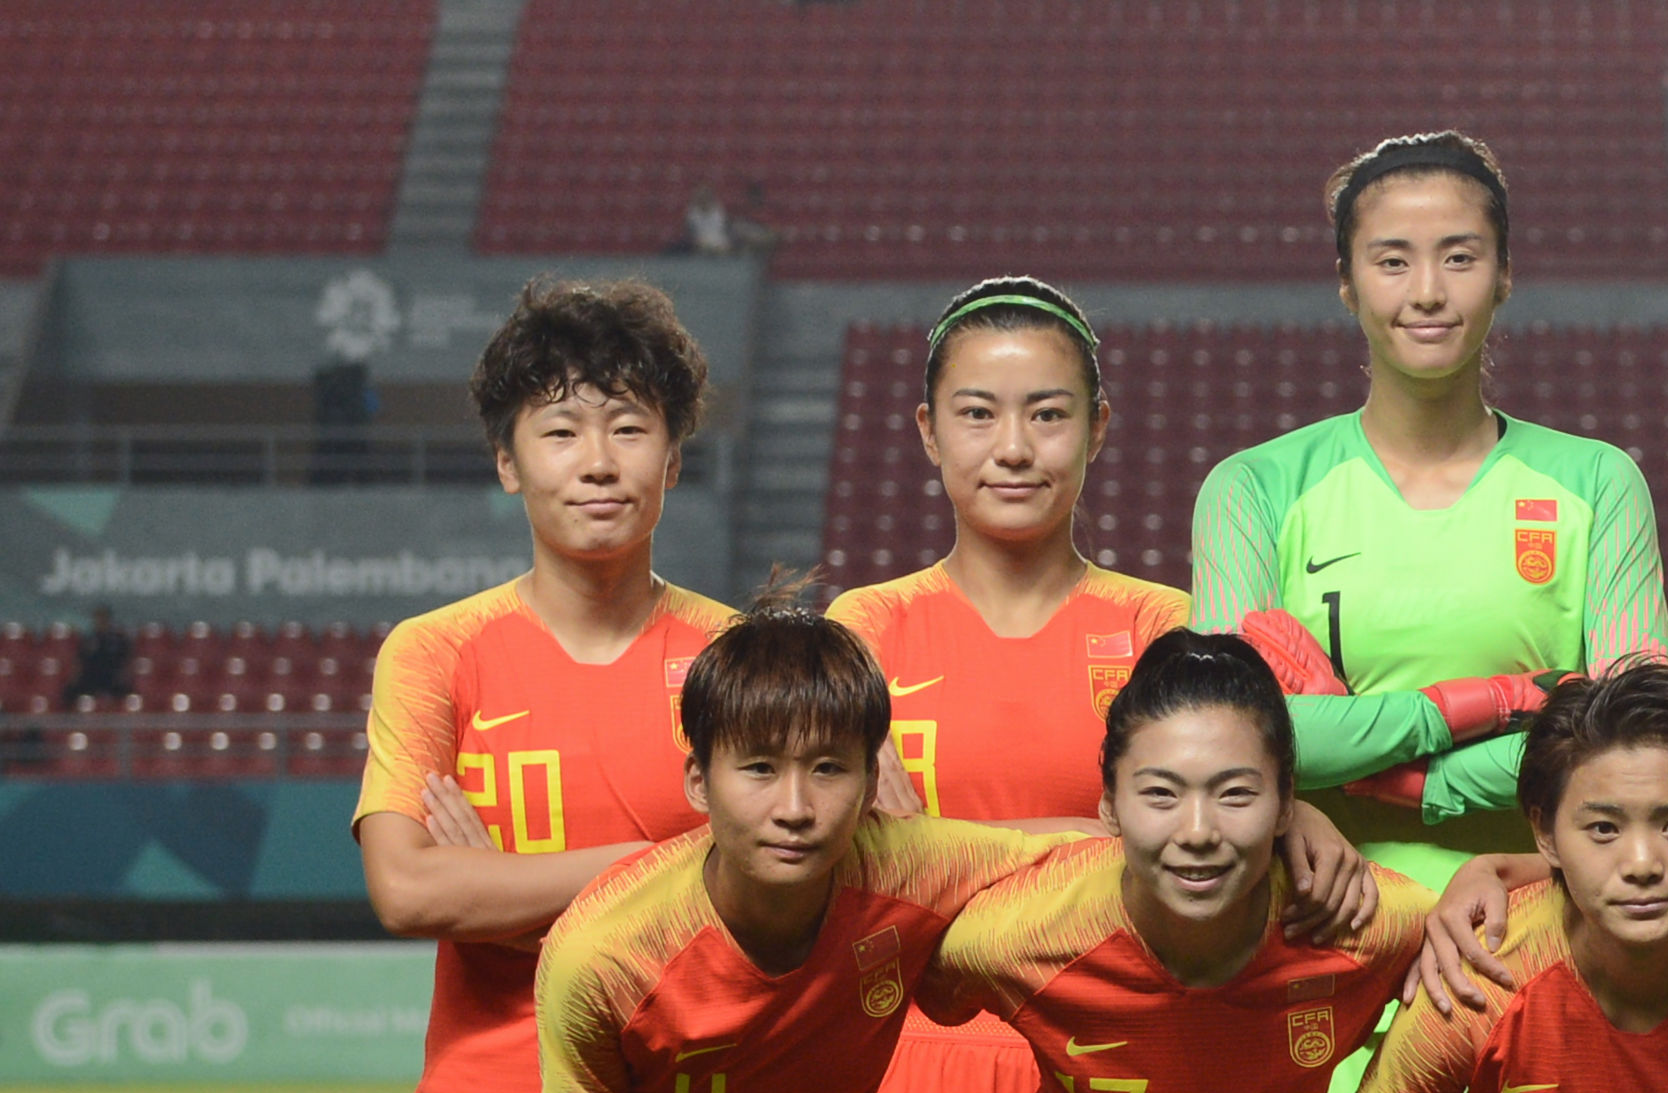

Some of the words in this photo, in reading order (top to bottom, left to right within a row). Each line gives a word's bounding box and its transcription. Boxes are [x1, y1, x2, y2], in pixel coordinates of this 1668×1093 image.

[1517, 531, 1553, 544] CFA
[44, 550, 235, 594] Jakarta
[1322, 591, 1353, 693] 1
[1093, 669, 1129, 680] CFA
[456, 750, 566, 854] 20
[35, 982, 247, 1066] Grab
[1292, 1010, 1329, 1027] CFA
